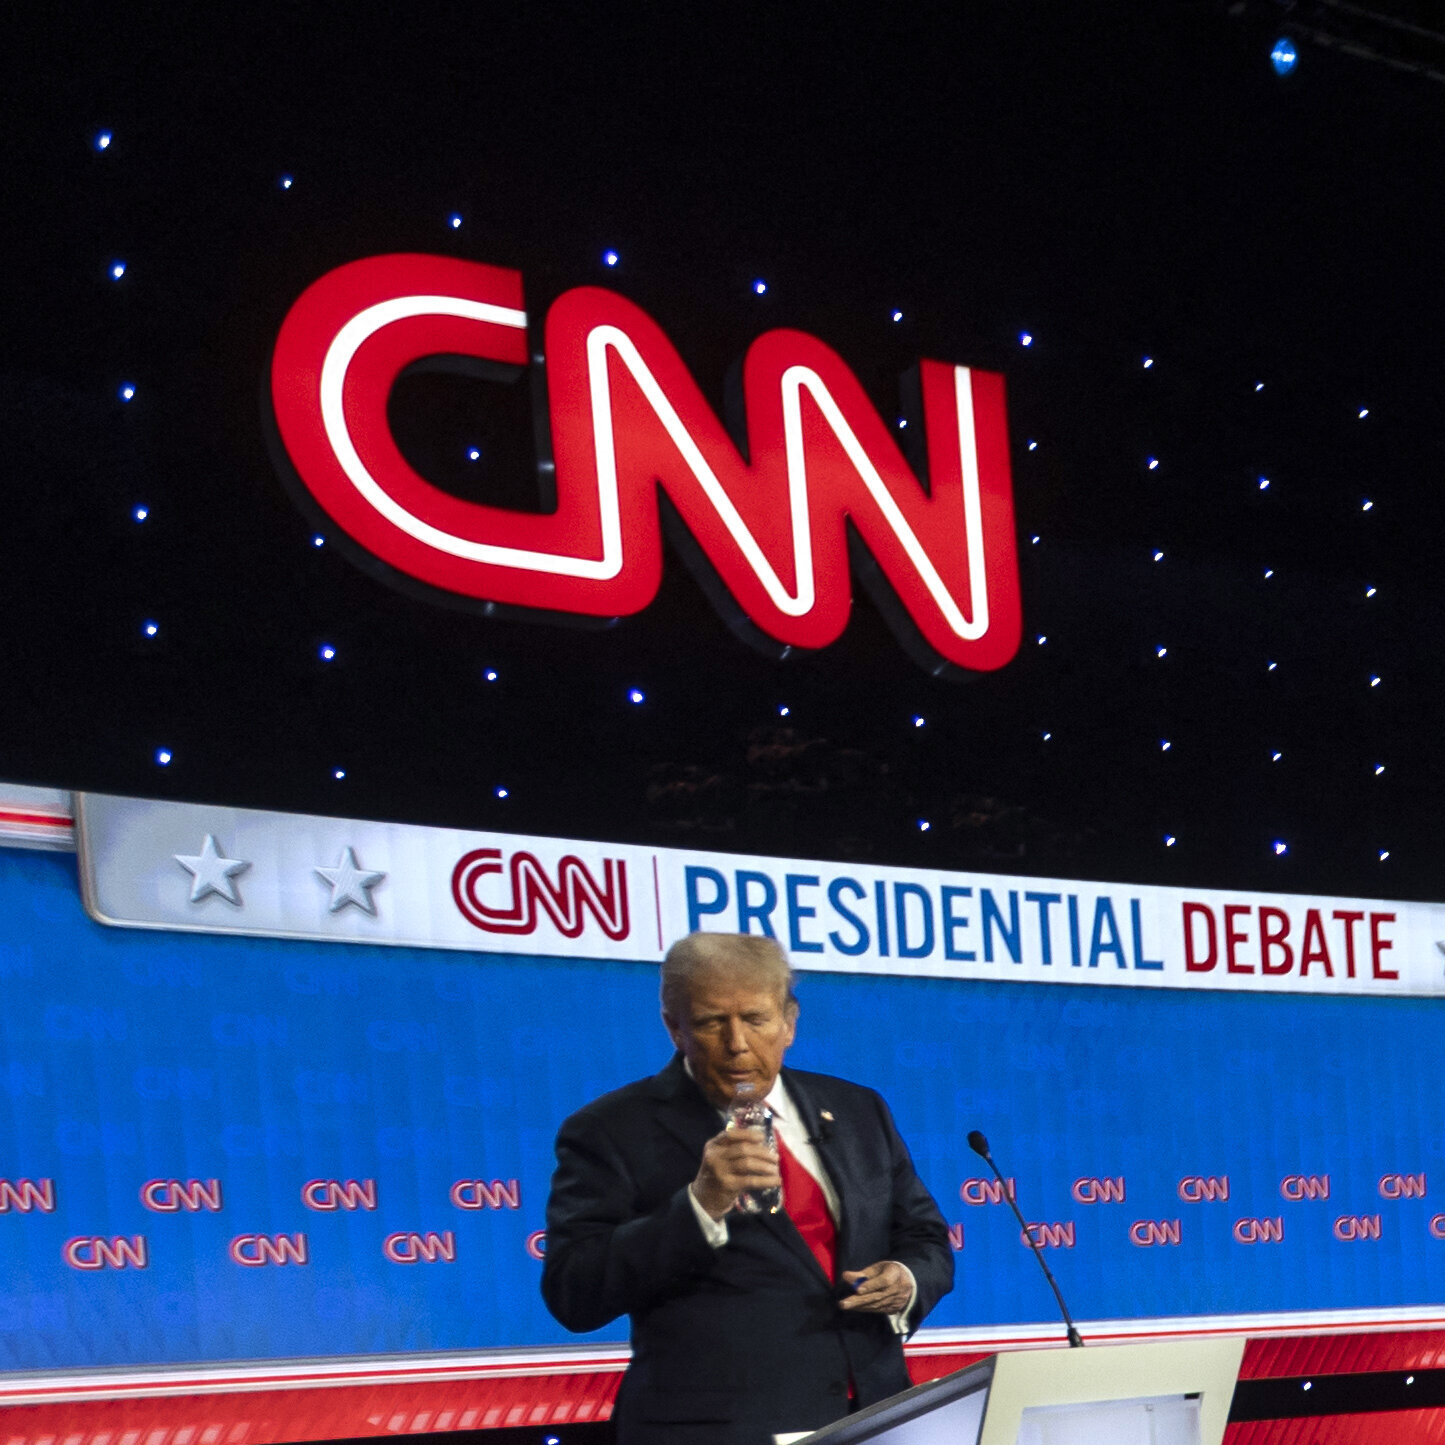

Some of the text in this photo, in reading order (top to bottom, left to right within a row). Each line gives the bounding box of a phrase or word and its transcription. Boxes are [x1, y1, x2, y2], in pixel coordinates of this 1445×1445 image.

[272, 253, 1022, 671] CNN
[451, 848, 1400, 980] CNN PRESIDENTIAL DEBATE
[0, 1178, 55, 1213] NN
[139, 1178, 221, 1213] CNN
[302, 1178, 377, 1212] CNN
[449, 1178, 520, 1211] CNN
[960, 1177, 1016, 1206] CNN
[1072, 1176, 1125, 1204] CNN
[1178, 1175, 1229, 1202] CNN
[1280, 1174, 1329, 1201] CNN
[1378, 1172, 1426, 1199] CNN
[1021, 1221, 1075, 1249] CNN
[1128, 1219, 1181, 1247] CNN
[1232, 1216, 1283, 1244] CNN
[1333, 1214, 1381, 1242] CNN
[62, 1234, 146, 1270] CNN
[228, 1232, 307, 1268] CNN
[382, 1231, 455, 1265] CNN
